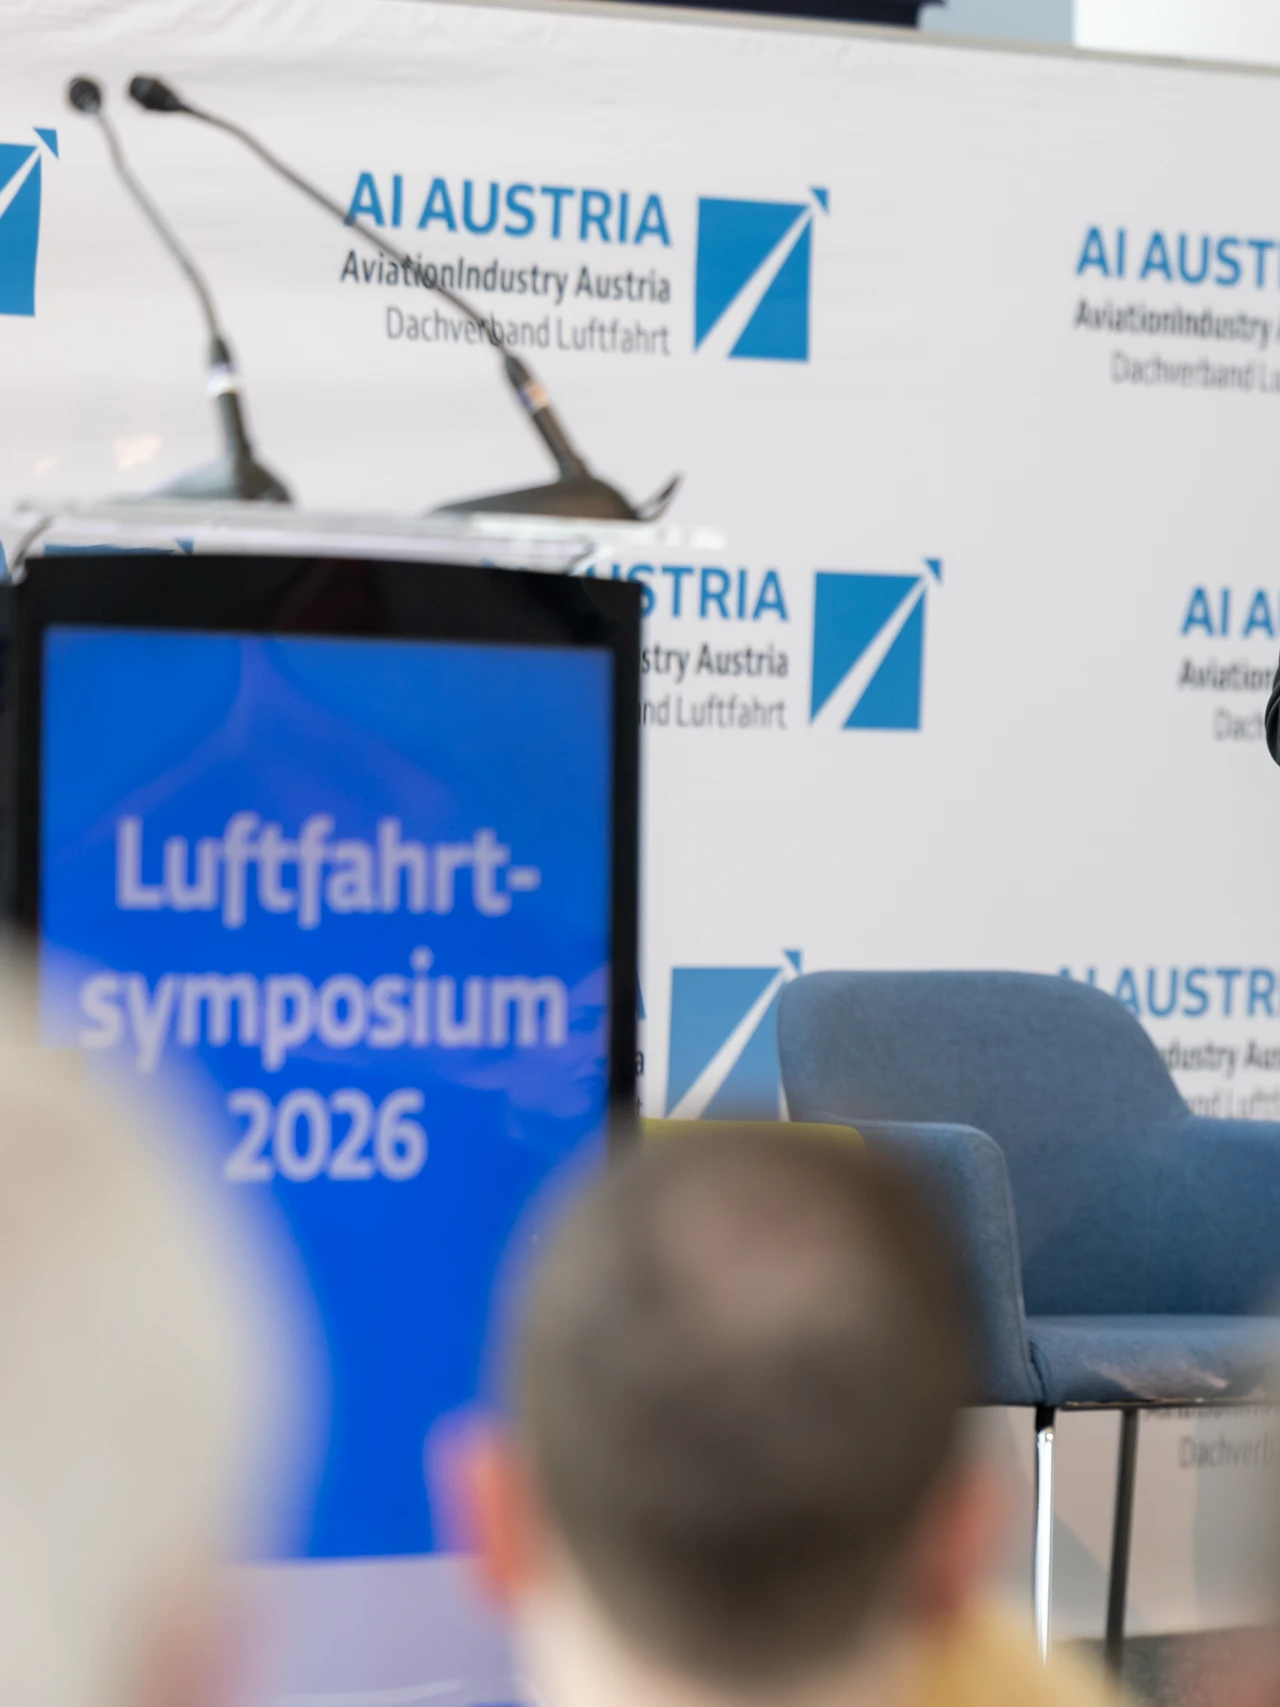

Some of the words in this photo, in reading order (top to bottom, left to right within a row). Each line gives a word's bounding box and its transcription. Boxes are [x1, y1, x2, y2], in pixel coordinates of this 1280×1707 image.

[344, 171, 403, 228] AI
[416, 177, 672, 247] AUSTRIA
[340, 250, 567, 306] AviationIndustry
[575, 264, 671, 304] Austria
[1075, 225, 1126, 279] AI
[386, 304, 550, 349] Dachverband
[556, 314, 671, 356] Luftfahrt
[1073, 299, 1271, 351] AviationIndustry
[586, 562, 789, 622] STRIA
[1180, 586, 1231, 638] AI
[695, 643, 788, 678] Austria
[675, 695, 787, 731] Luftfahrt
[115, 811, 541, 931] Luftfahrt-
[79, 946, 568, 1072] symposium
[223, 1087, 429, 1183] 2026
